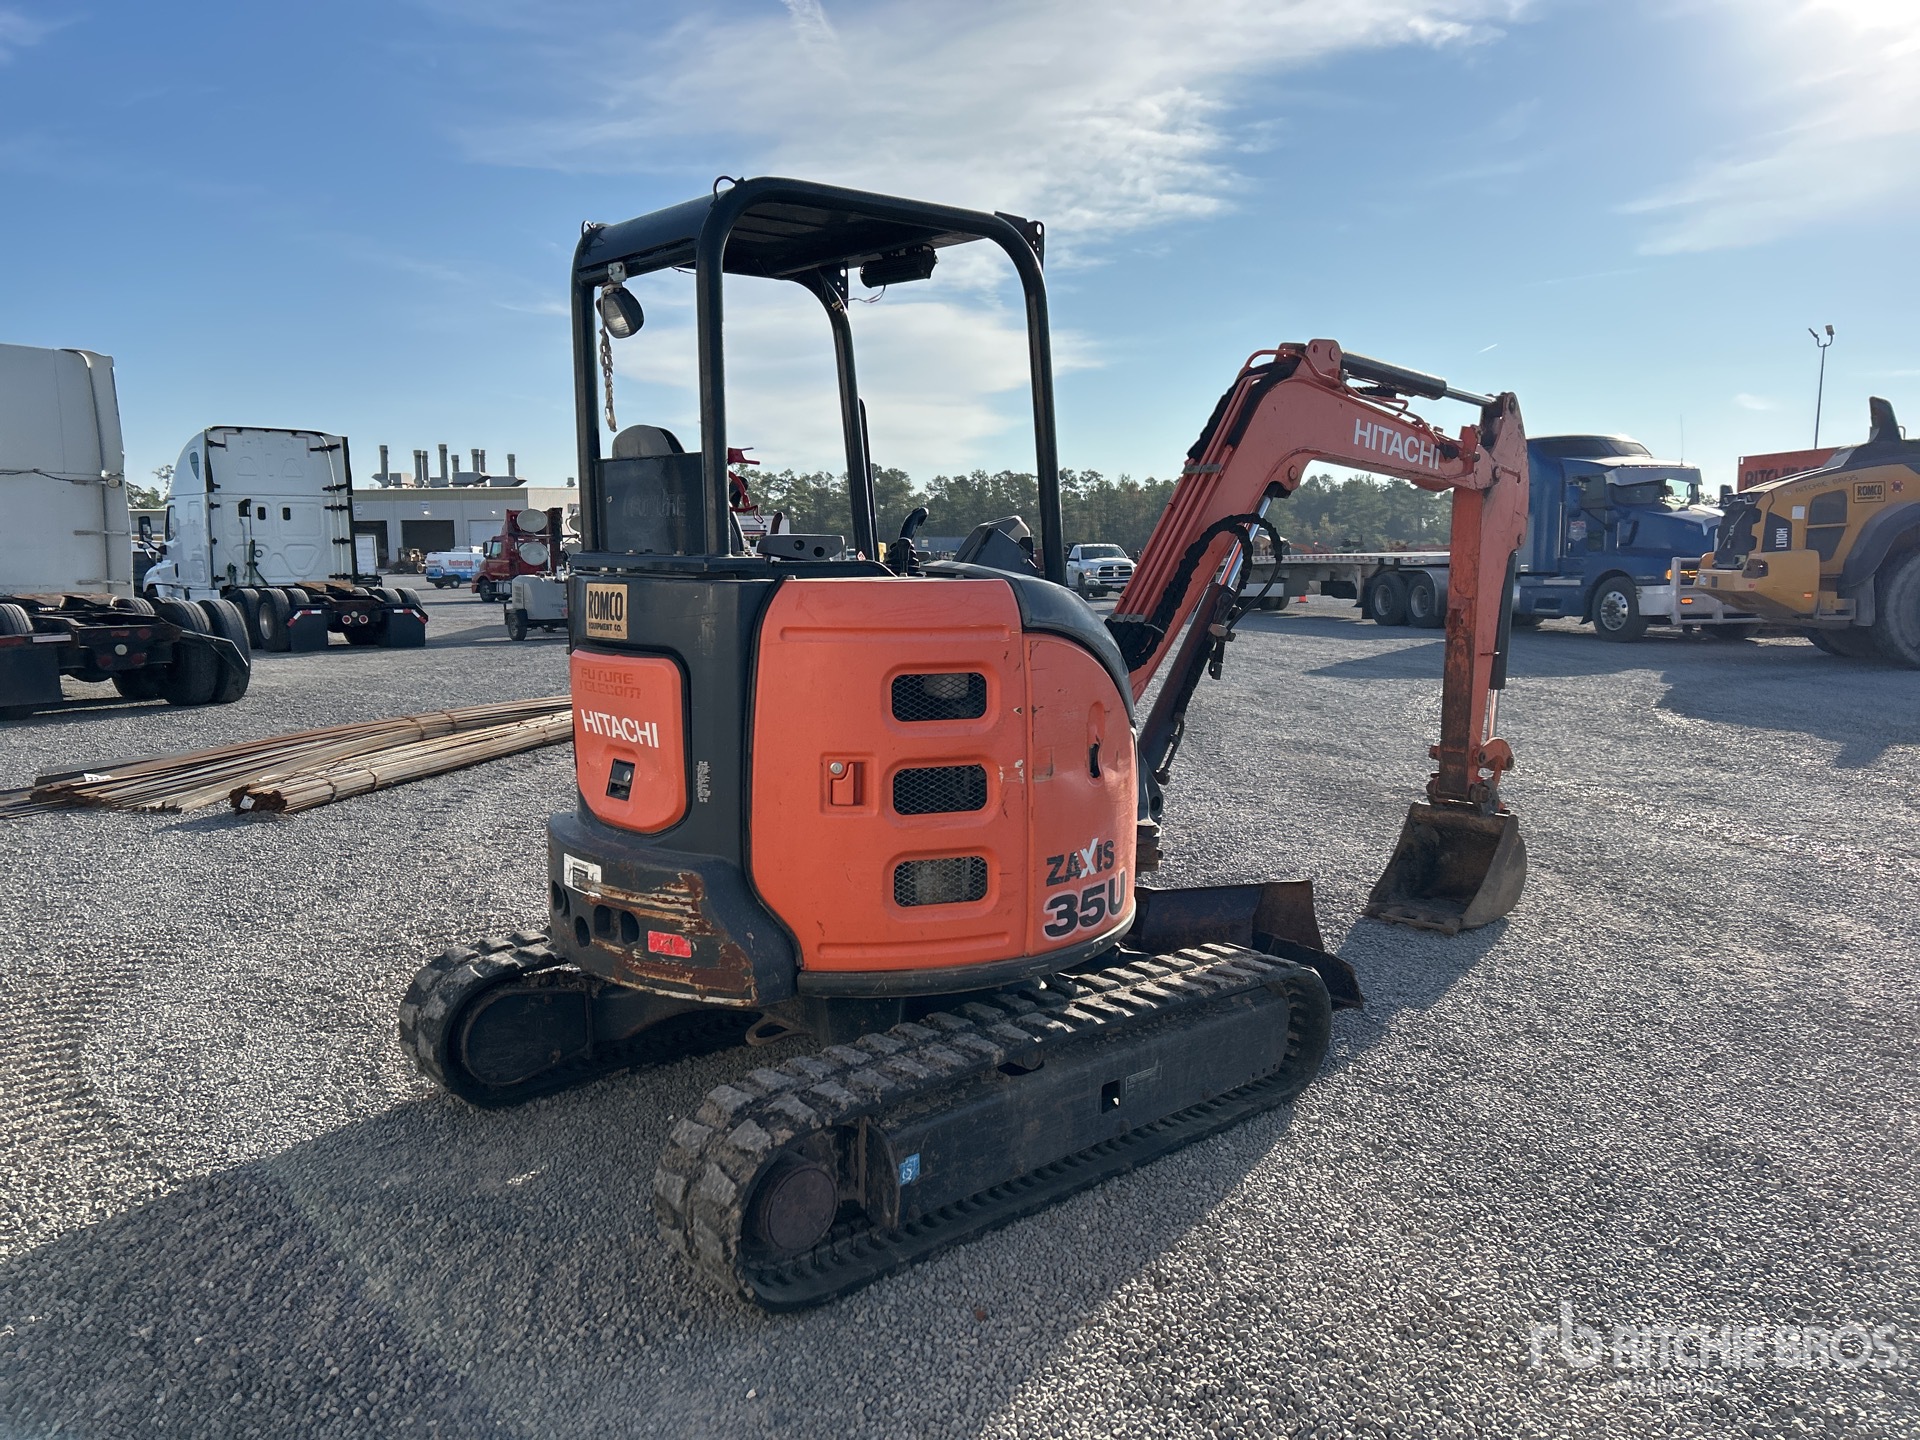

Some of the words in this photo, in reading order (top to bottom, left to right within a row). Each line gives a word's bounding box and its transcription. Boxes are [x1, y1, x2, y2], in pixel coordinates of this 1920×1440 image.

[1354, 419, 1440, 470] HITACHI
[1857, 484, 1883, 497] ROMCO
[588, 590, 624, 622] ROMCO
[588, 621, 613, 632] EQUIPMENT
[613, 623, 623, 632] CO.
[581, 667, 634, 685] FUTURE
[580, 708, 660, 749] HITACHI
[1046, 838, 1115, 886] ZAXIS
[1043, 869, 1127, 939] 35U
